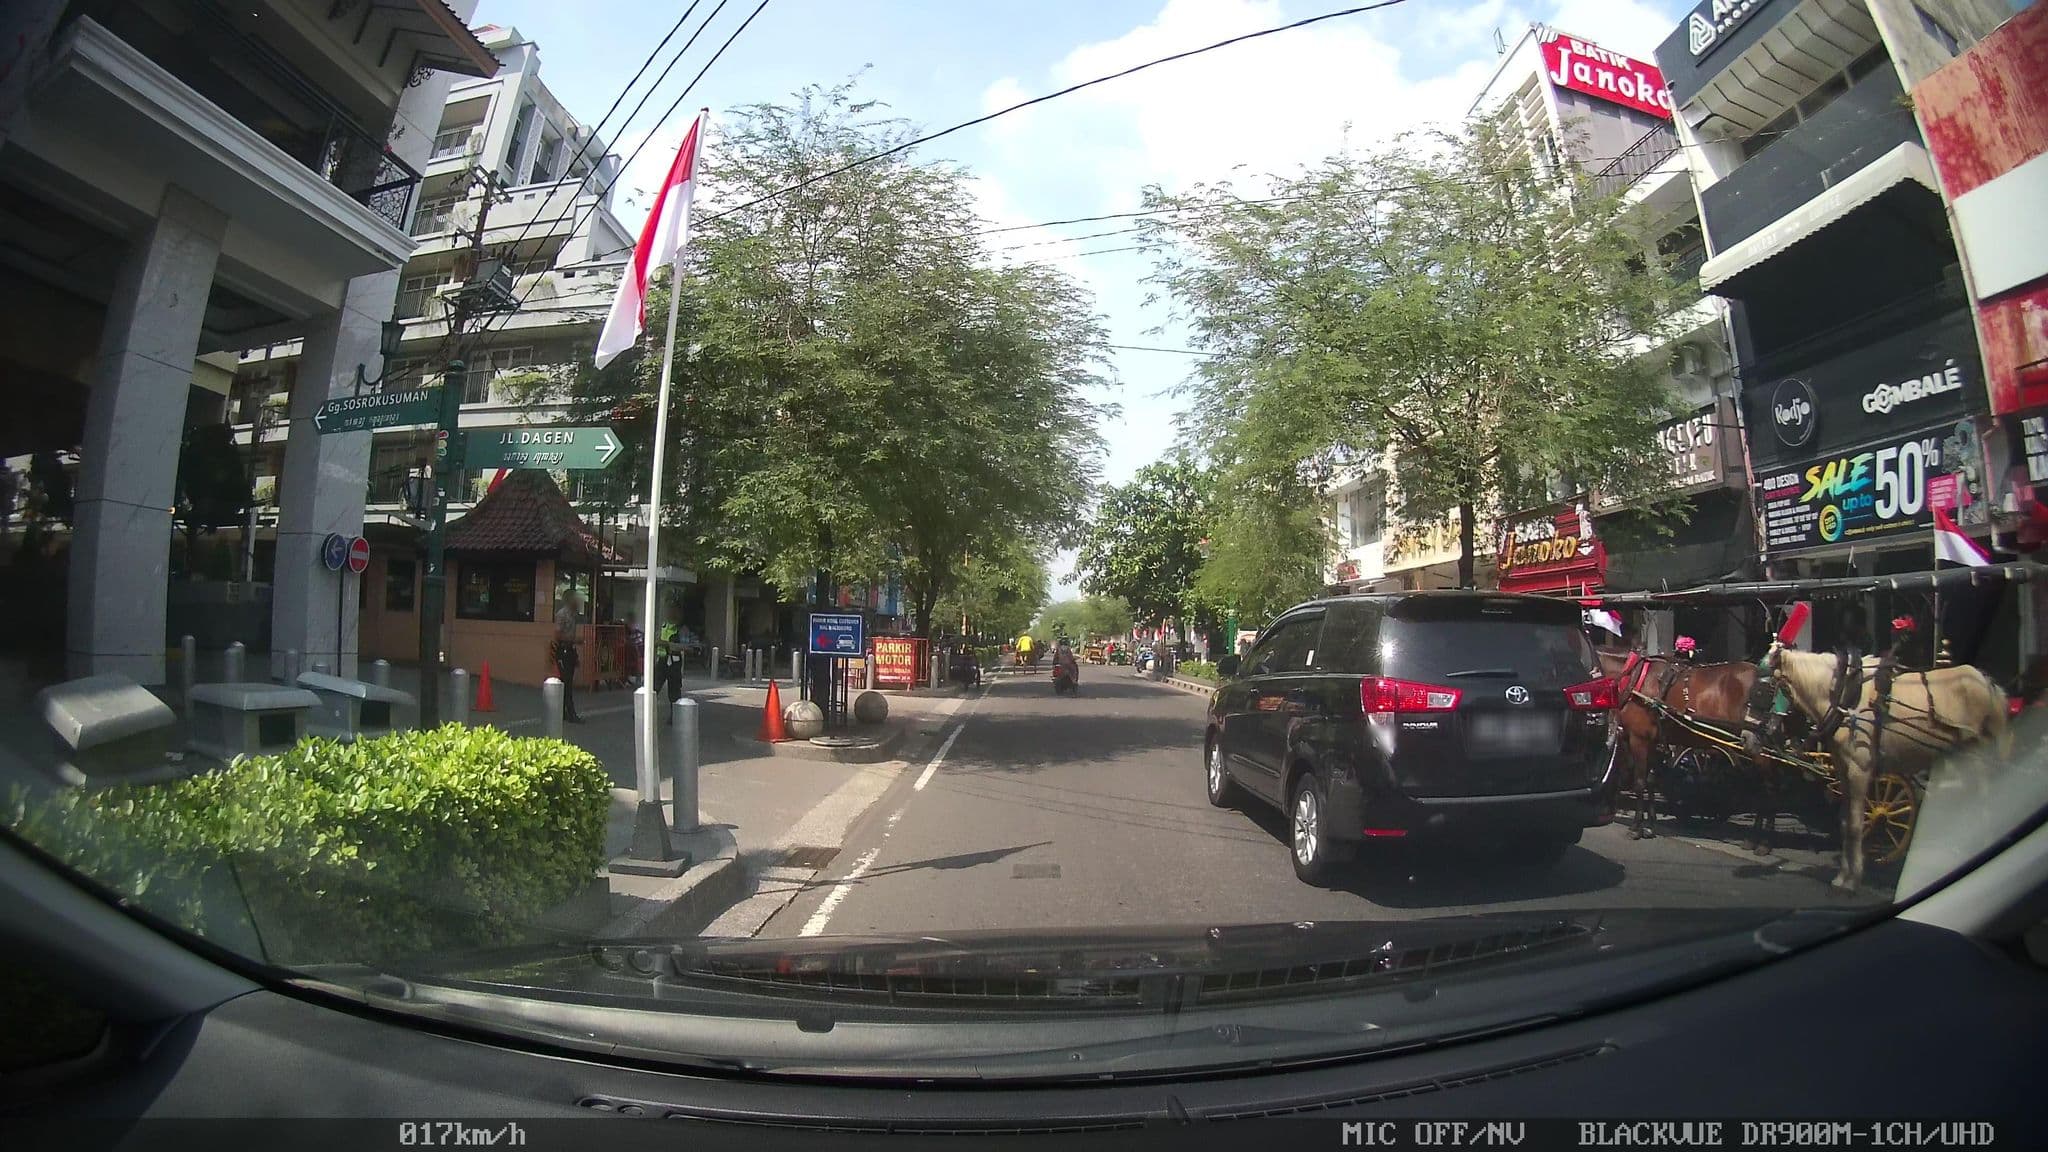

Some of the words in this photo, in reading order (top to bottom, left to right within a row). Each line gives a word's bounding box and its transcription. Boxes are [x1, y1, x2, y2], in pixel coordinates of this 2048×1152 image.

[1569, 39, 1631, 71] BATIK
[1862, 358, 1962, 414] GOMBALÉ
[500, 431, 574, 445] JL.DAGEN
[1799, 452, 1874, 503] SALE
[1842, 497, 1858, 513] up
[1860, 493, 1873, 509] to
[876, 642, 912, 654] PARKIR
[875, 654, 912, 666] MOTOR
